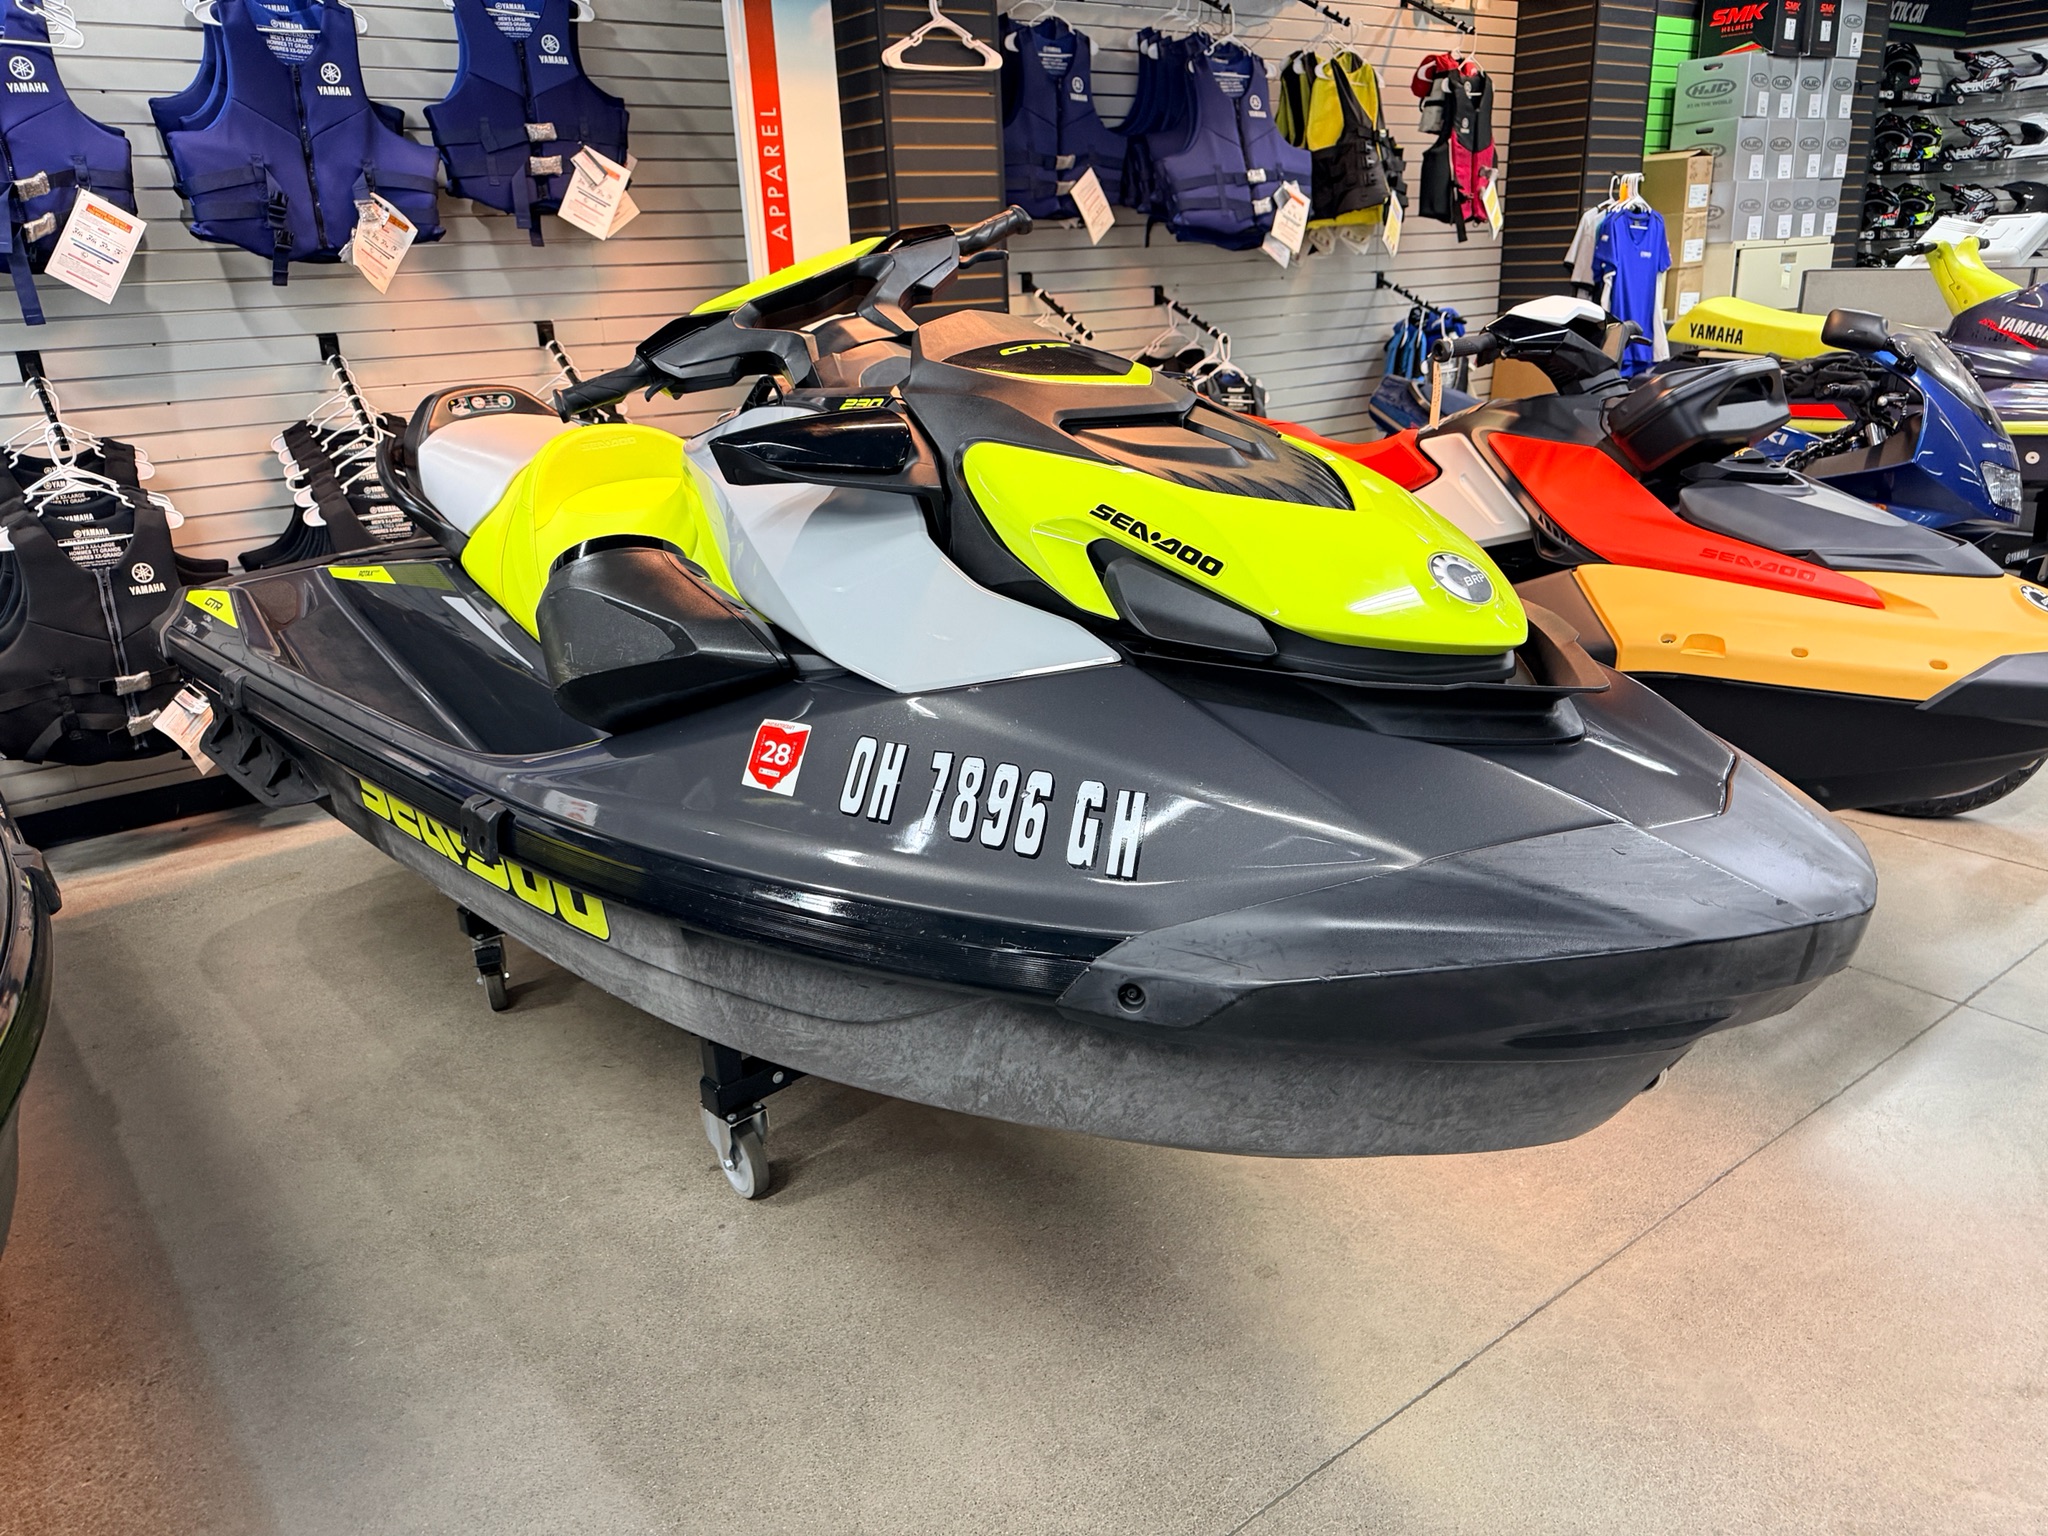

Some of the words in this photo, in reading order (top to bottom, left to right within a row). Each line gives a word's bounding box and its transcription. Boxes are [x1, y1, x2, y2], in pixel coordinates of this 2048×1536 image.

[1784, 0, 1801, 11] SMK
[1820, 3, 1836, 13] SMK
[1709, 2, 1769, 27] SMK
[1908, 3, 1930, 24] CAT
[278, 21, 303, 30] YAMAHA
[1721, 22, 1753, 33] HELMETS
[538, 55, 569, 65] YAMAHA
[5, 82, 49, 93] YAMAHA
[317, 86, 352, 96] YAMAHA
[760, 107, 788, 241] APPAREL
[1690, 322, 1744, 345] YAMAHA
[1000, 342, 1071, 356] GTR
[839, 397, 884, 411] 230
[65, 513, 94, 521] YAMAHA
[81, 528, 110, 536] YAMAHA
[2011, 549, 2029, 562] YAMAHA
[1463, 573, 1485, 586] BRP
[129, 583, 167, 596] YAMAHA
[204, 597, 223, 611] GTR
[760, 740, 792, 766] 28
[839, 736, 909, 824] OH
[920, 751, 1055, 859] 7896
[1067, 780, 1148, 881] GH
